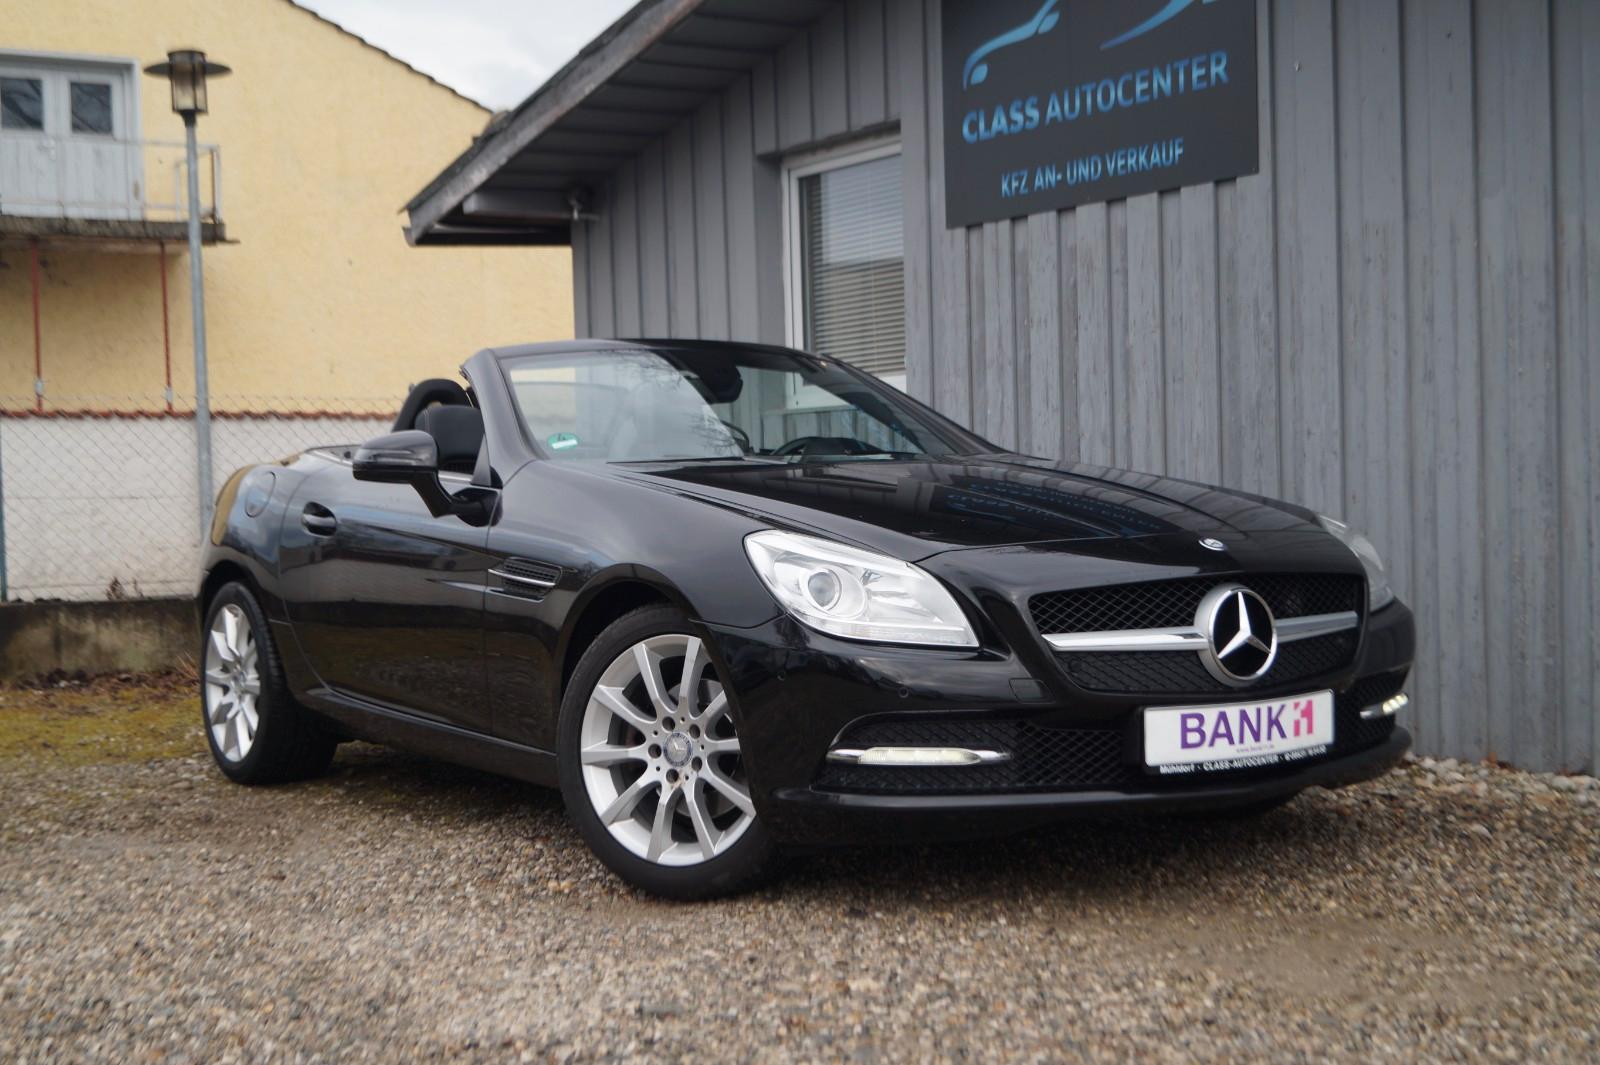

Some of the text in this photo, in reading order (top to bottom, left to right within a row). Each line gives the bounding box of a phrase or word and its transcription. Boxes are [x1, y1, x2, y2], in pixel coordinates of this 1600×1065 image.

[962, 50, 1230, 144] CLASS AUTOCENTER
[1001, 138, 1184, 199] KFZ AN- UND VERKAUF
[1180, 703, 1287, 750] BANK
